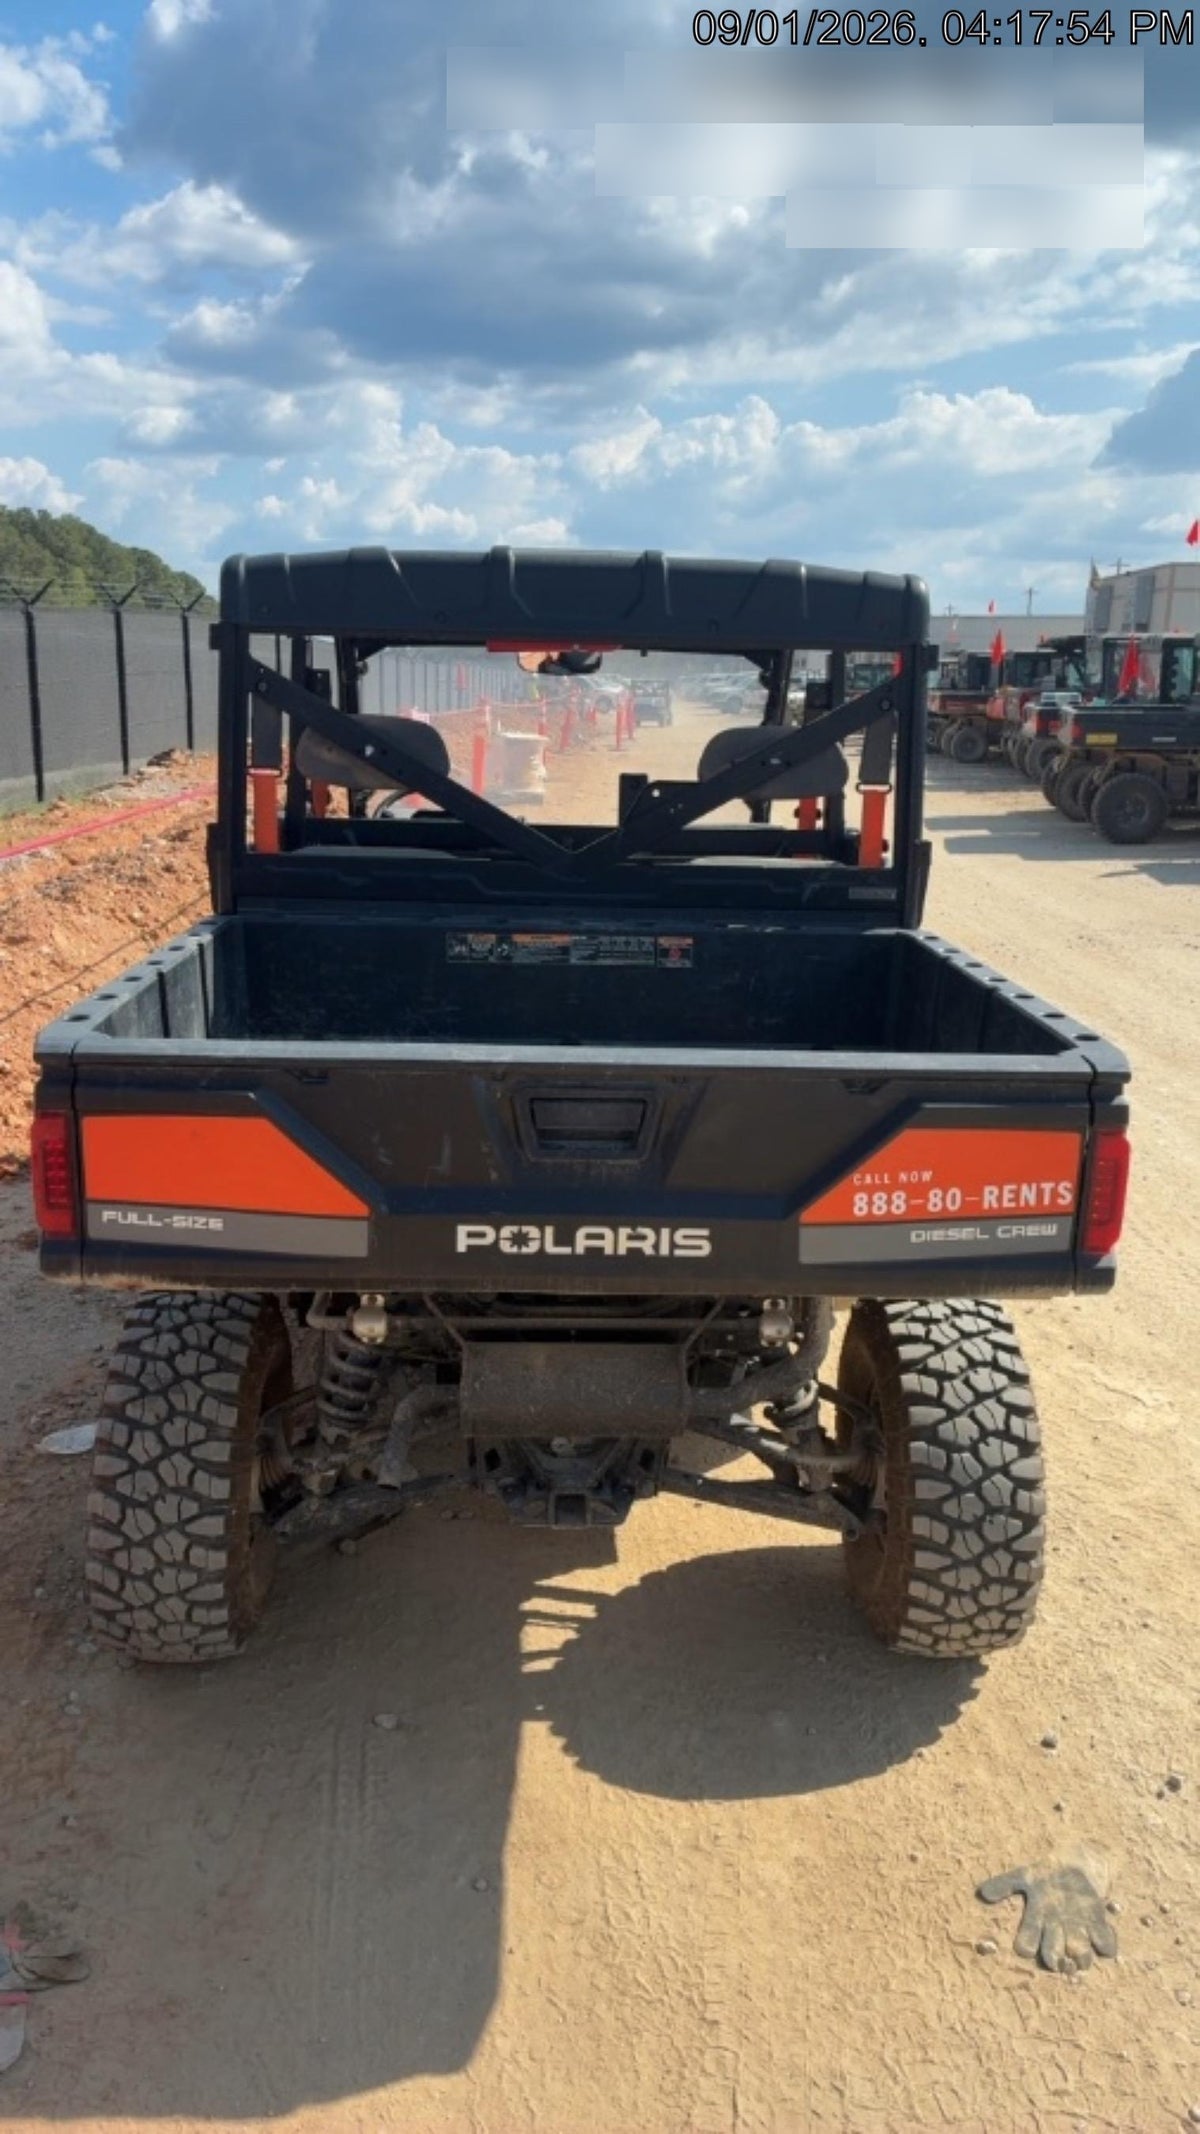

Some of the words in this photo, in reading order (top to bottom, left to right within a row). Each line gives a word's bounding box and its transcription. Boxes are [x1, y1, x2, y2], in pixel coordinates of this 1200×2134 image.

[852, 1173, 891, 1186] CALL
[899, 1170, 933, 1183] NOW
[852, 1182, 1074, 1217] 888-80-RENTS
[101, 1210, 224, 1232] FULL-SIZE
[455, 1224, 713, 1258] POLARIS
[910, 1227, 990, 1243] DIESEL
[996, 1223, 1059, 1239] CREW
